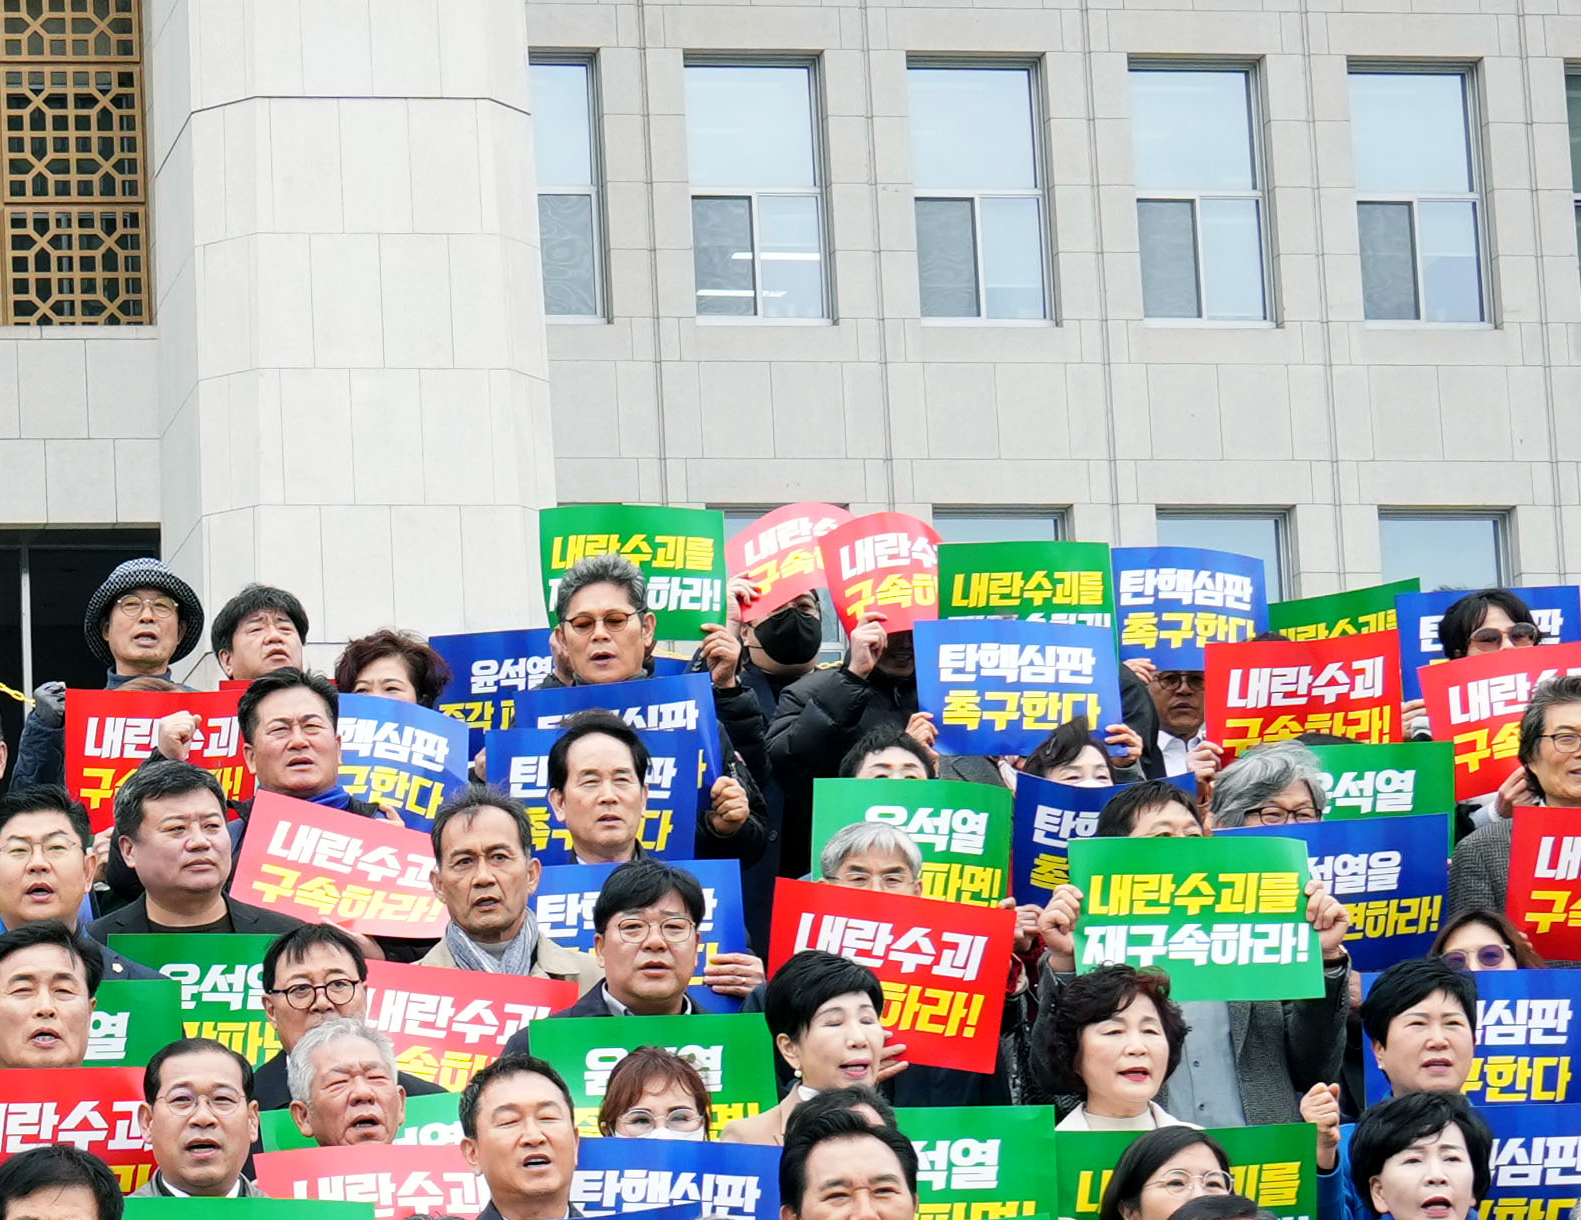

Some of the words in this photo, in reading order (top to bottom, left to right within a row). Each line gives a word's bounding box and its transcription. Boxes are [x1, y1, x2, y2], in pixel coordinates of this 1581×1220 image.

[552, 535, 716, 572] 내란수괴를
[952, 572, 1103, 609] 내란수괴를
[1120, 568, 1253, 609] 탄핵심판
[1123, 611, 1256, 646] 촉구한다
[939, 646, 1096, 685] 탄핵심판
[1228, 661, 1385, 707] 내란수괴
[944, 695, 1102, 730] 촉구한다
[336, 722, 449, 763] 핵심판
[267, 824, 436, 890] 내란수괴
[1309, 851, 1403, 894] 석열을
[253, 865, 448, 921] 구속하라!
[1092, 871, 1299, 918] 내란수괴를
[1344, 894, 1444, 937] 면하라!
[797, 914, 986, 978] 내란수괴
[1082, 924, 1310, 968] 재구속하라!
[366, 984, 553, 1041] 내란수괴
[914, 1138, 999, 1189] 석열
